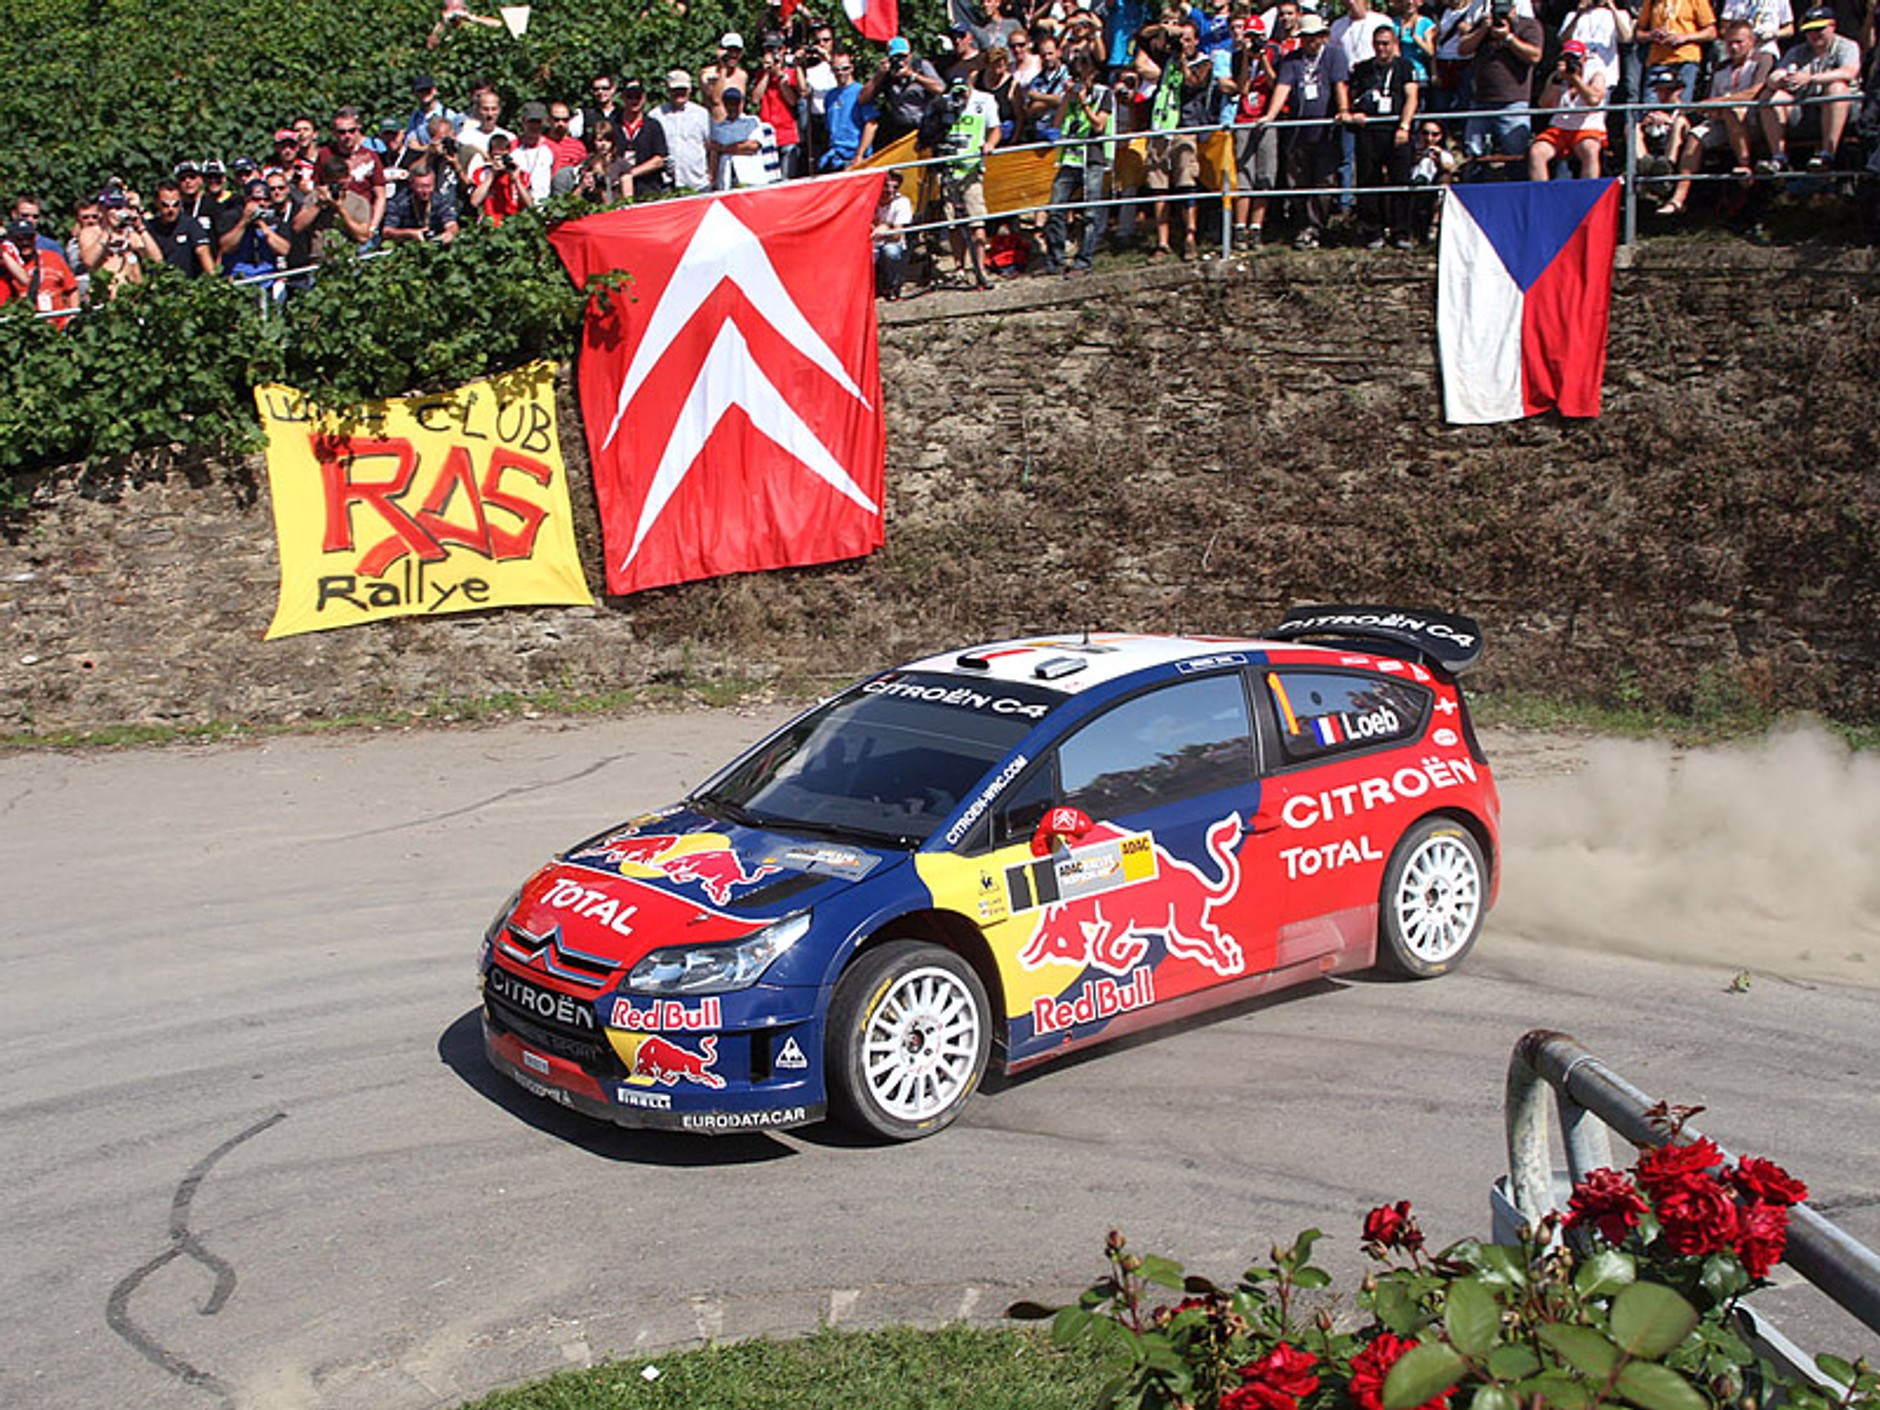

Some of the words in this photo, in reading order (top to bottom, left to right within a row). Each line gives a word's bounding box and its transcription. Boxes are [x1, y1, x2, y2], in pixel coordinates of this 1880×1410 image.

[415, 391, 551, 452] CLUB
[309, 433, 553, 579] RAS
[316, 559, 490, 612] Rallye
[1278, 613, 1426, 631] CITROËN
[1426, 624, 1476, 648] C4
[863, 681, 992, 709] CITROËN
[992, 698, 1049, 719] C4
[1342, 705, 1399, 740] Loeb
[1281, 756, 1478, 829] CITROËN
[1279, 836, 1384, 880] TOTAL
[540, 878, 639, 937] TOTAL
[490, 968, 594, 1030] CITROËN
[612, 998, 661, 1029] Red
[663, 998, 721, 1030] Bull
[1034, 982, 1095, 1034] Red
[1096, 968, 1154, 1017] Bull
[683, 1107, 806, 1128] EURODATACAR
